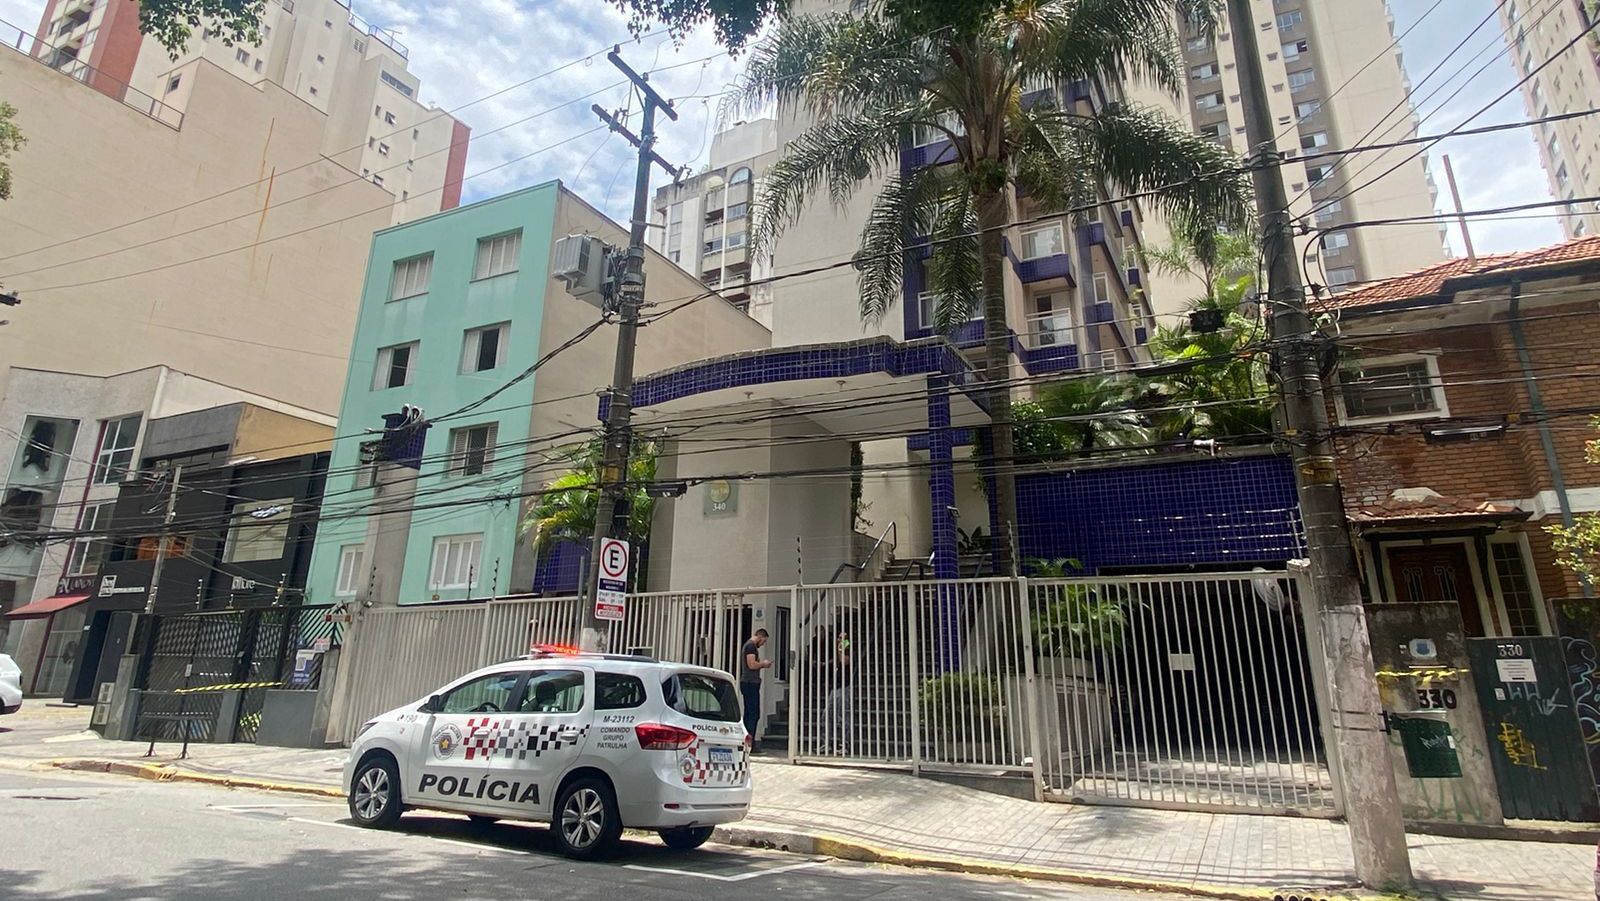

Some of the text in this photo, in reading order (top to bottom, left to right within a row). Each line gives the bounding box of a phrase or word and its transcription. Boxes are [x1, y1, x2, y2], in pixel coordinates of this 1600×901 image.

[712, 502, 726, 511] 340
[610, 550, 619, 569] E
[1497, 644, 1523, 656] 330
[1416, 689, 1457, 710] 330
[602, 715, 635, 723] M-23112
[692, 724, 718, 732] POLÍCIA
[597, 742, 628, 750] PATRULHA
[418, 773, 541, 805] POLÍCIA
